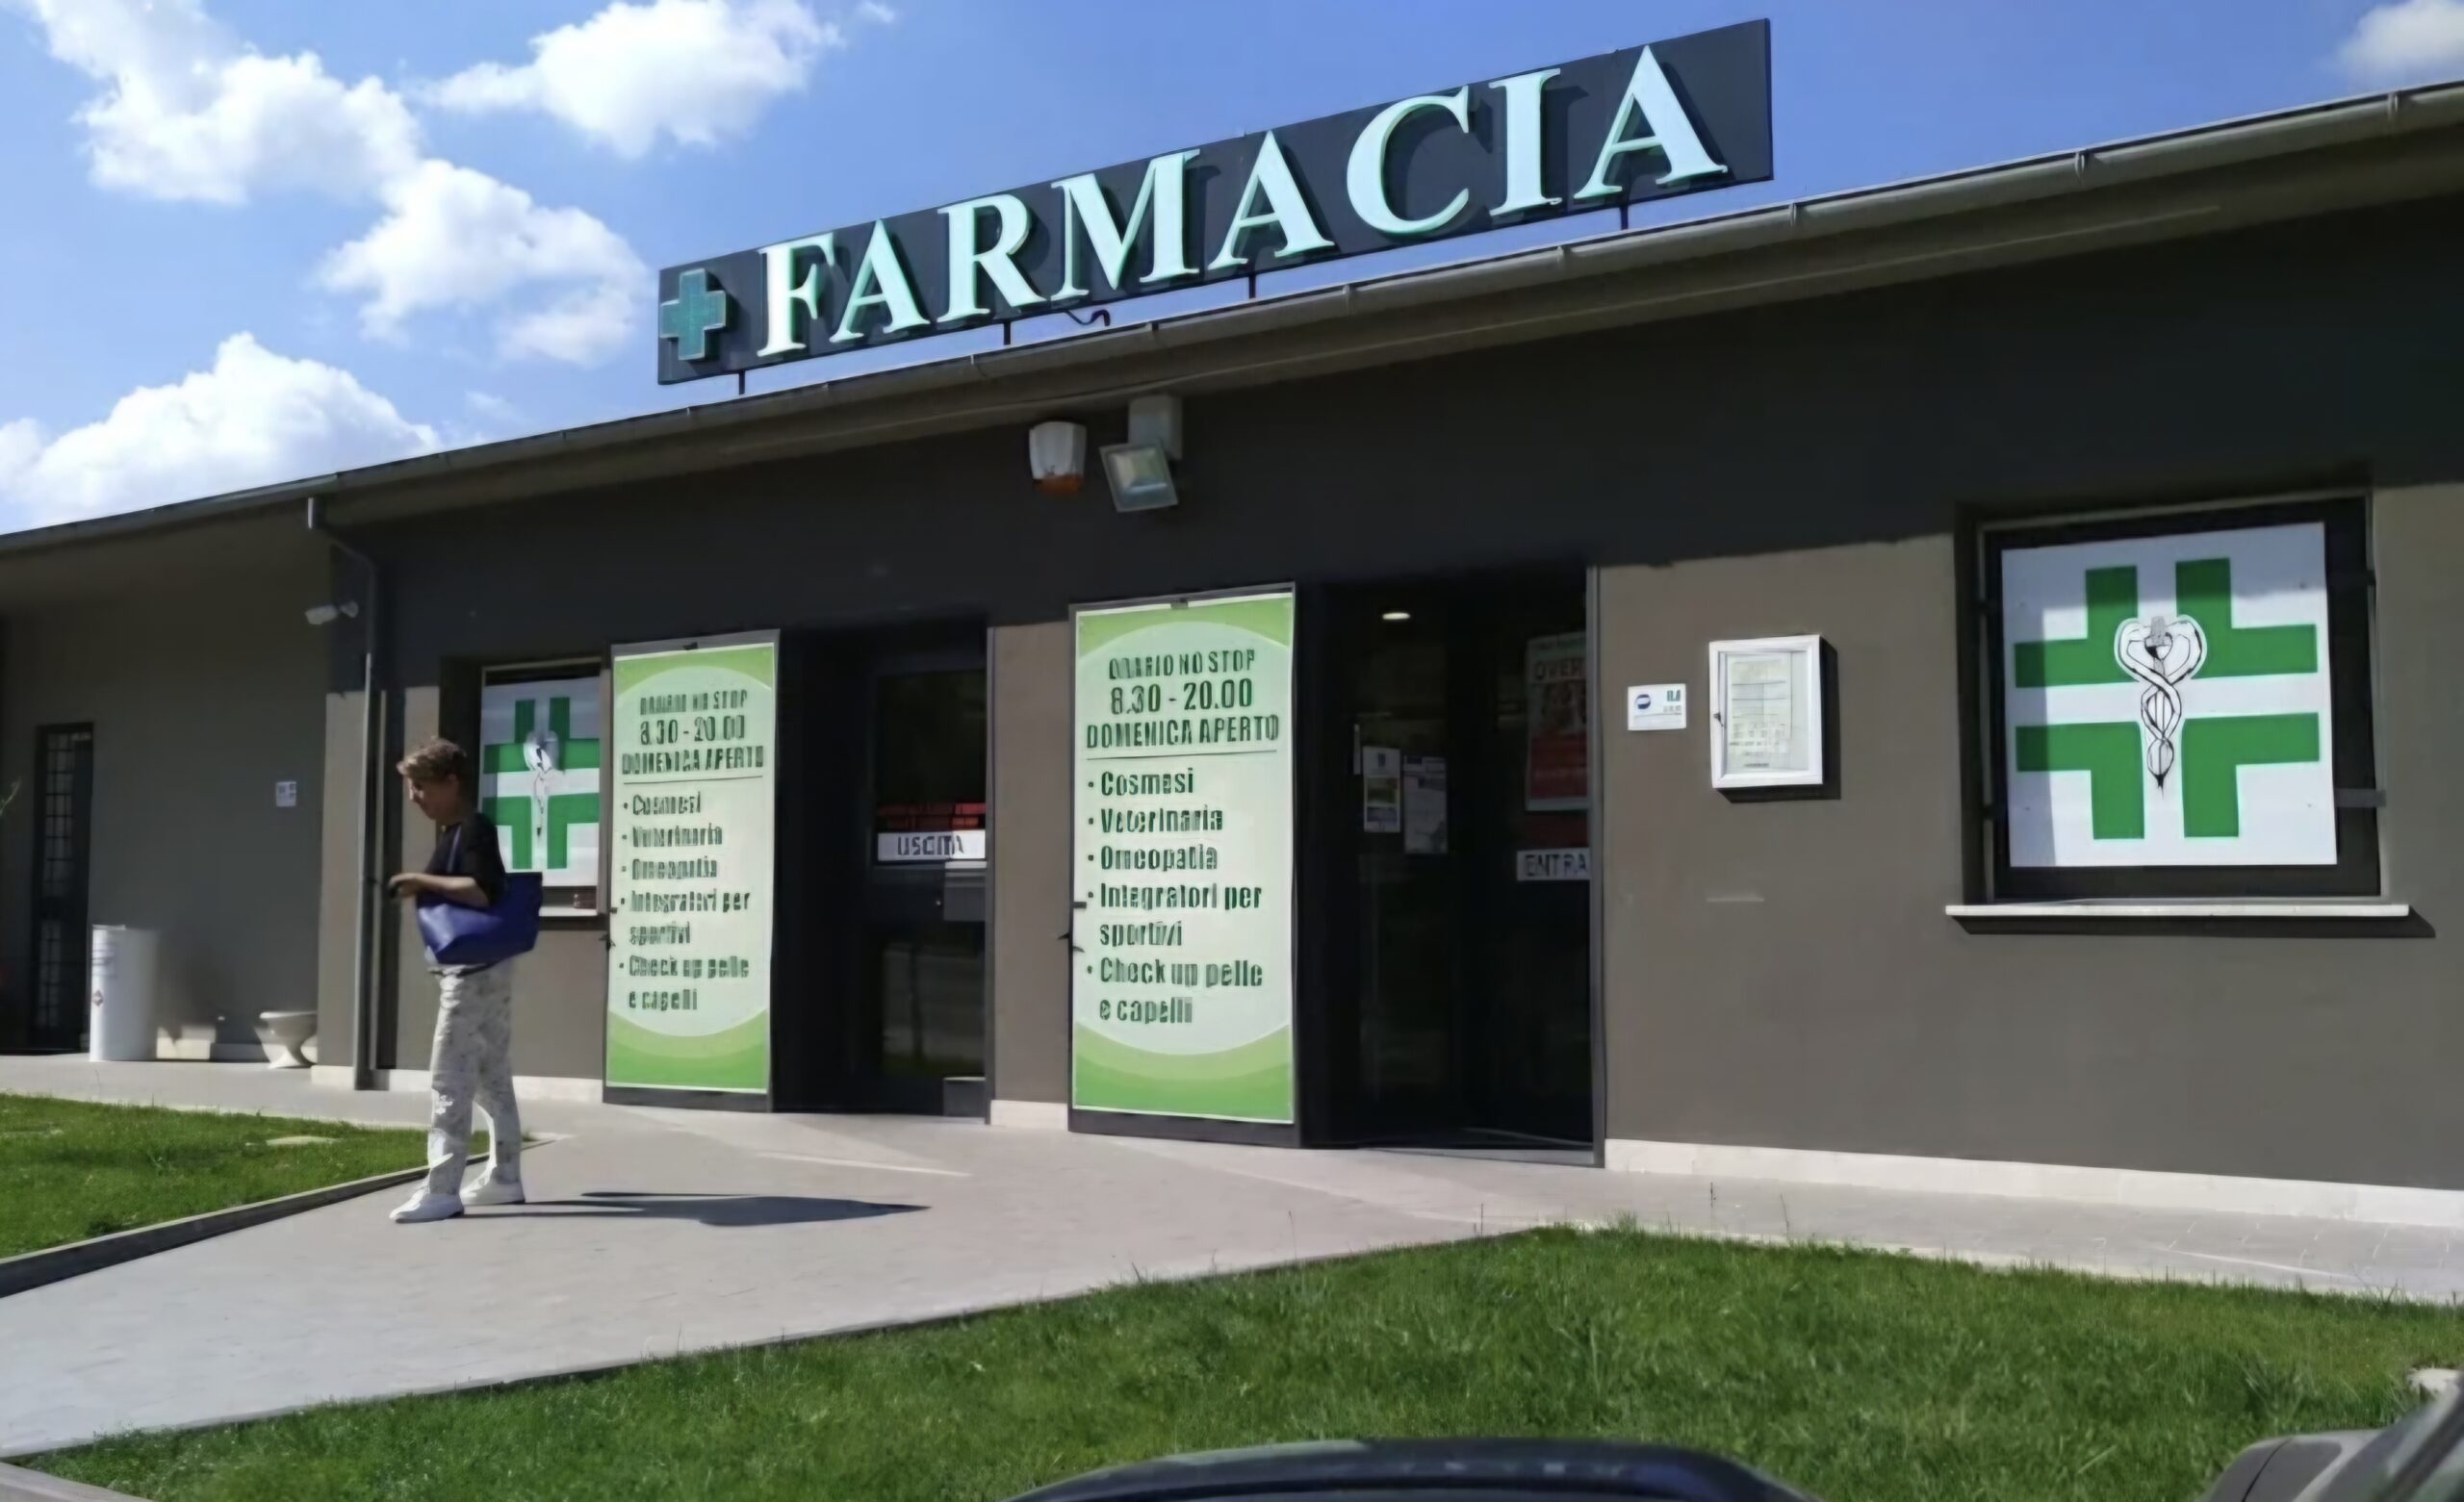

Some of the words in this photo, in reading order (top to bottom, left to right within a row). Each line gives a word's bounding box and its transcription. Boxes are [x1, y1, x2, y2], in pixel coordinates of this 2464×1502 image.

[757, 44, 1728, 358] FARMACIA
[1109, 654, 1173, 679] ORARIO
[1179, 651, 1202, 675] NO
[1208, 649, 1254, 674] STOP
[1112, 684, 1161, 715] 8.30
[1183, 678, 1252, 710] 20.00
[1087, 720, 1193, 748] DOMENICA
[1199, 715, 1279, 743] APERTO
[1101, 768, 1194, 796] Cosmesi
[1101, 804, 1222, 832] Veterinaria
[1101, 844, 1218, 872] Omeopatia
[1101, 882, 1217, 910] Integratori
[1224, 886, 1262, 910] per
[1100, 921, 1182, 947] sportivi
[1101, 957, 1166, 983] Check
[1171, 963, 1198, 987] up
[1205, 960, 1263, 987] pelle
[629, 991, 636, 1008] e
[1100, 1000, 1111, 1020] e
[1117, 997, 1193, 1024] capelli
